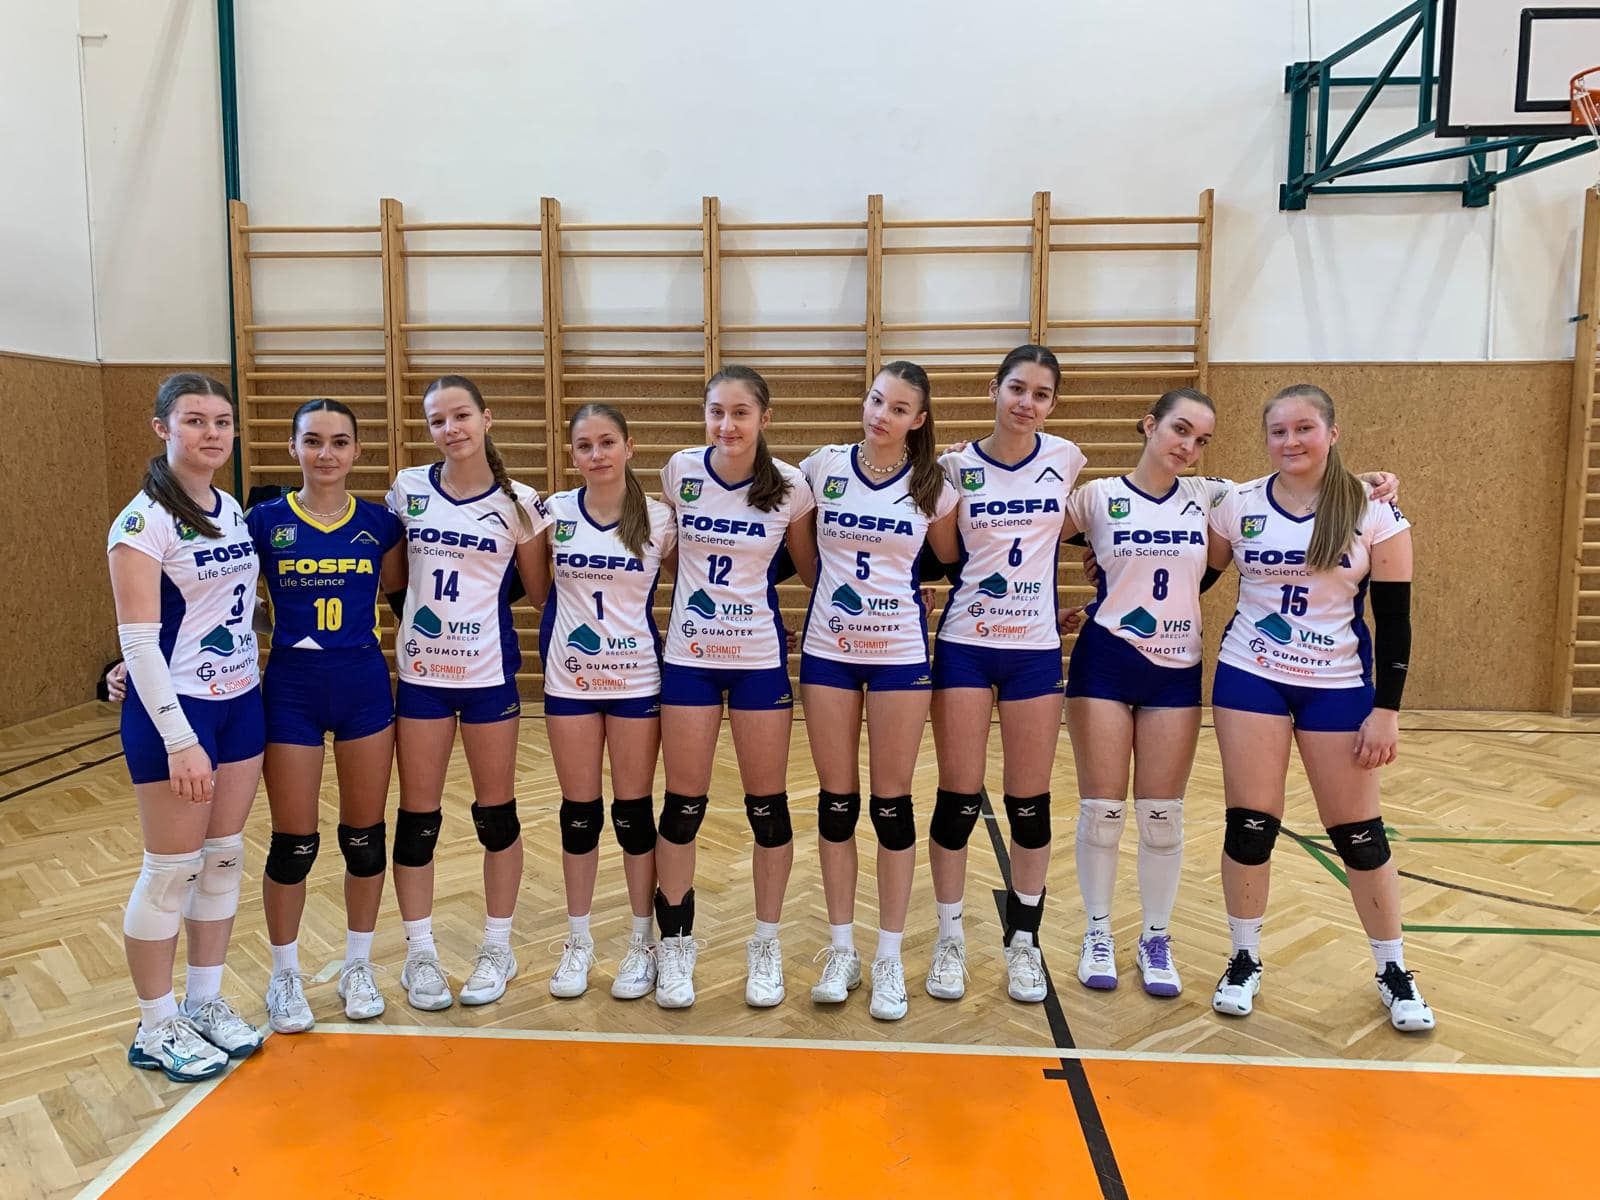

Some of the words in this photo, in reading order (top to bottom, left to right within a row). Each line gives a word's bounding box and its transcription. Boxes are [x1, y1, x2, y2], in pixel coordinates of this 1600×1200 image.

[970, 498, 1060, 518] FOSFA
[682, 514, 766, 537] FOSFA
[824, 510, 913, 536] FOSFA
[971, 520, 988, 530] Life
[991, 518, 1032, 528] Science
[408, 528, 497, 553] FOSFA
[695, 533, 736, 546] Science
[823, 527, 837, 538] Life
[839, 530, 882, 543] Science
[1113, 530, 1205, 545] FOSFA
[193, 541, 256, 567] FOSF
[423, 548, 464, 560] Science
[1008, 538, 1022, 567] 6
[1114, 548, 1133, 558] Life
[1136, 548, 1180, 557] Science
[278, 559, 373, 574] FOSFA
[556, 553, 644, 572] FOSFA
[856, 551, 871, 580] 5
[198, 569, 219, 580] Life
[221, 562, 252, 576] Science
[572, 571, 613, 580] Science
[707, 554, 732, 586] 12
[280, 578, 297, 587] Life
[300, 577, 345, 586] Science
[432, 569, 459, 602] 14
[1014, 582, 1041, 594] VHS
[1153, 568, 1169, 600] 8
[231, 584, 246, 616] 3
[592, 591, 604, 620] 1
[867, 598, 899, 610] VHS
[1280, 584, 1309, 617] 15
[313, 598, 342, 631] 10
[722, 604, 753, 615] VHS
[989, 608, 1039, 616] GUMOTEX
[448, 621, 480, 634] VHS
[702, 628, 753, 636] GUMOTEX
[848, 624, 900, 632] GUMOTEX
[992, 625, 1028, 634] SCHMIDT
[1163, 620, 1191, 632] VHS
[607, 637, 637, 649] VHS
[1299, 629, 1334, 646] VHS
[706, 644, 741, 655] SCHMIDT
[853, 640, 889, 649] SCHMIDT
[426, 647, 479, 656] GUMOTEX
[1272, 650, 1332, 666] GUMOTEX
[430, 663, 467, 674] SCHMIDT
[586, 662, 638, 670] GUMOTEX
[591, 678, 627, 687] SCHMIDT
